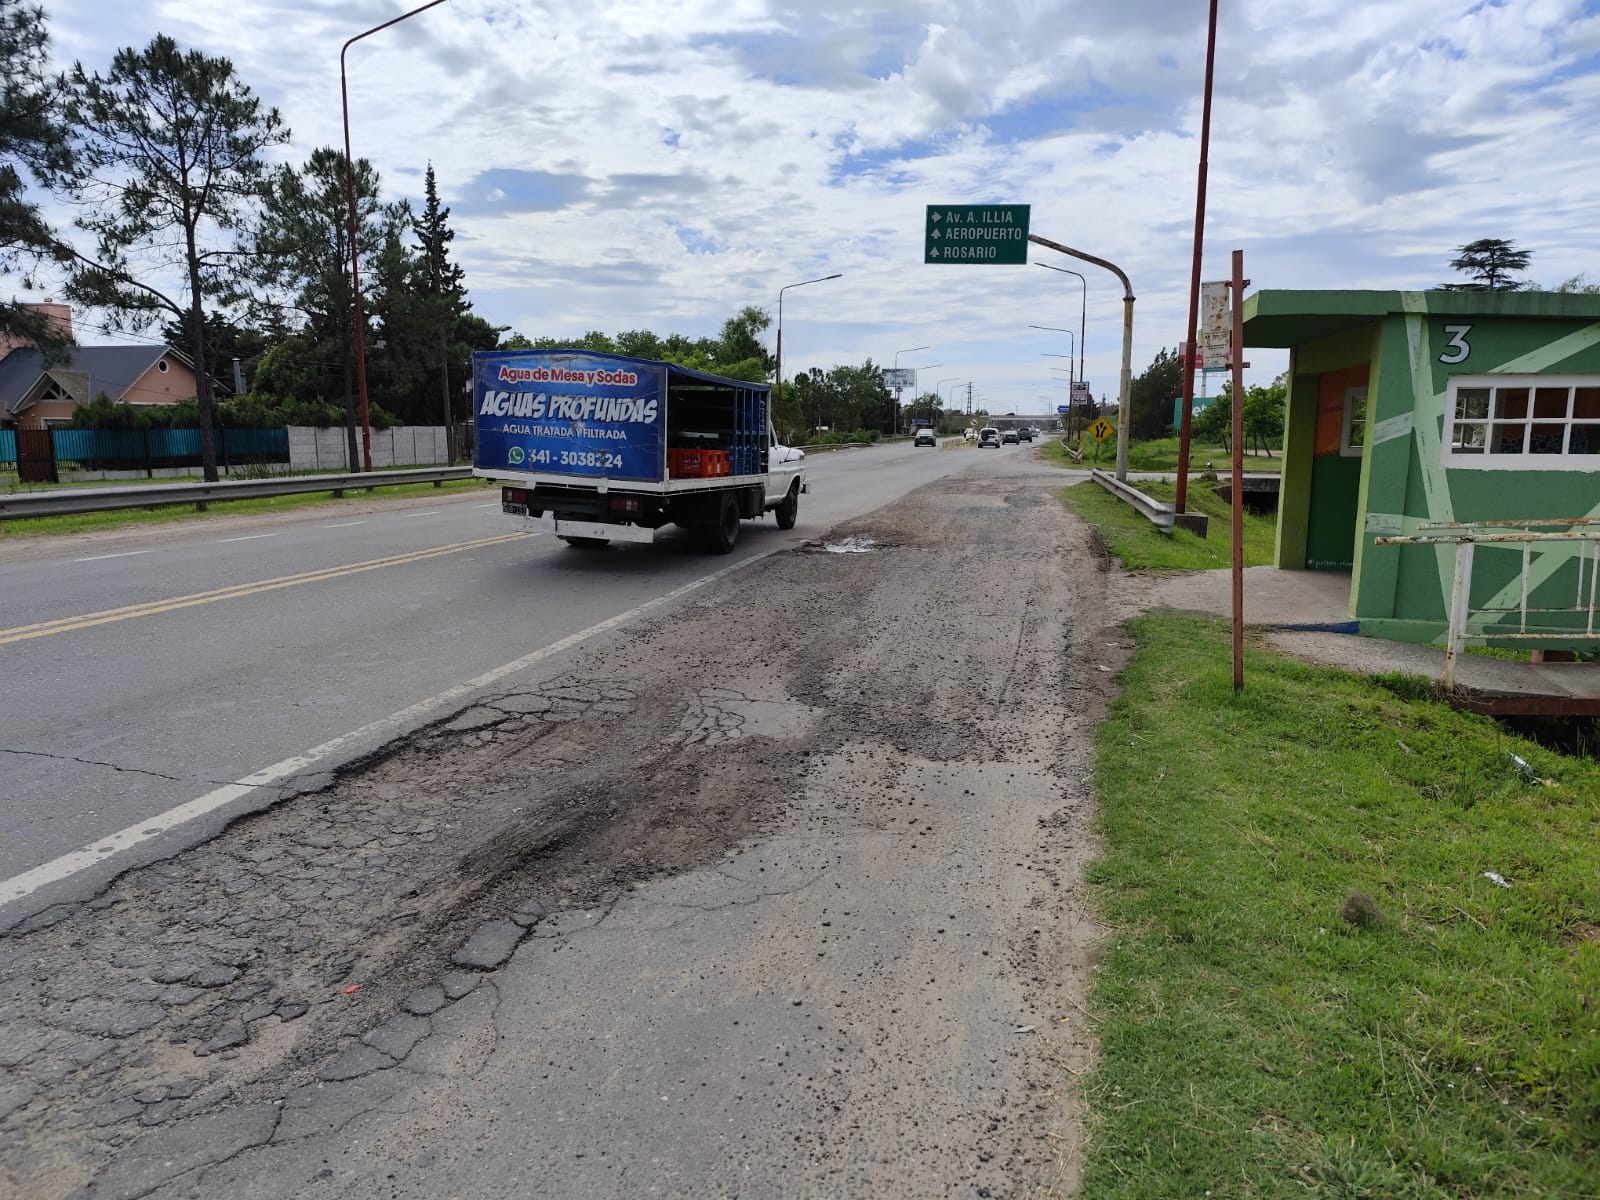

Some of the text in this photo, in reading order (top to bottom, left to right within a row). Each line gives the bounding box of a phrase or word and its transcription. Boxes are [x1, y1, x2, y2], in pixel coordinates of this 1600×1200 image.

[946, 211, 1013, 223] Av. A. ILLIA
[945, 227, 1022, 240] AEROPUERTO
[943, 246, 997, 259] ROSARIO
[1439, 324, 1472, 365] 3
[499, 366, 637, 386] Agua de Mesa y Sodas
[479, 390, 658, 424] AGUAS PROFUNDAS
[502, 423, 627, 440] AGUA TRATADA Y FILTRADA
[528, 448, 550, 465] 341
